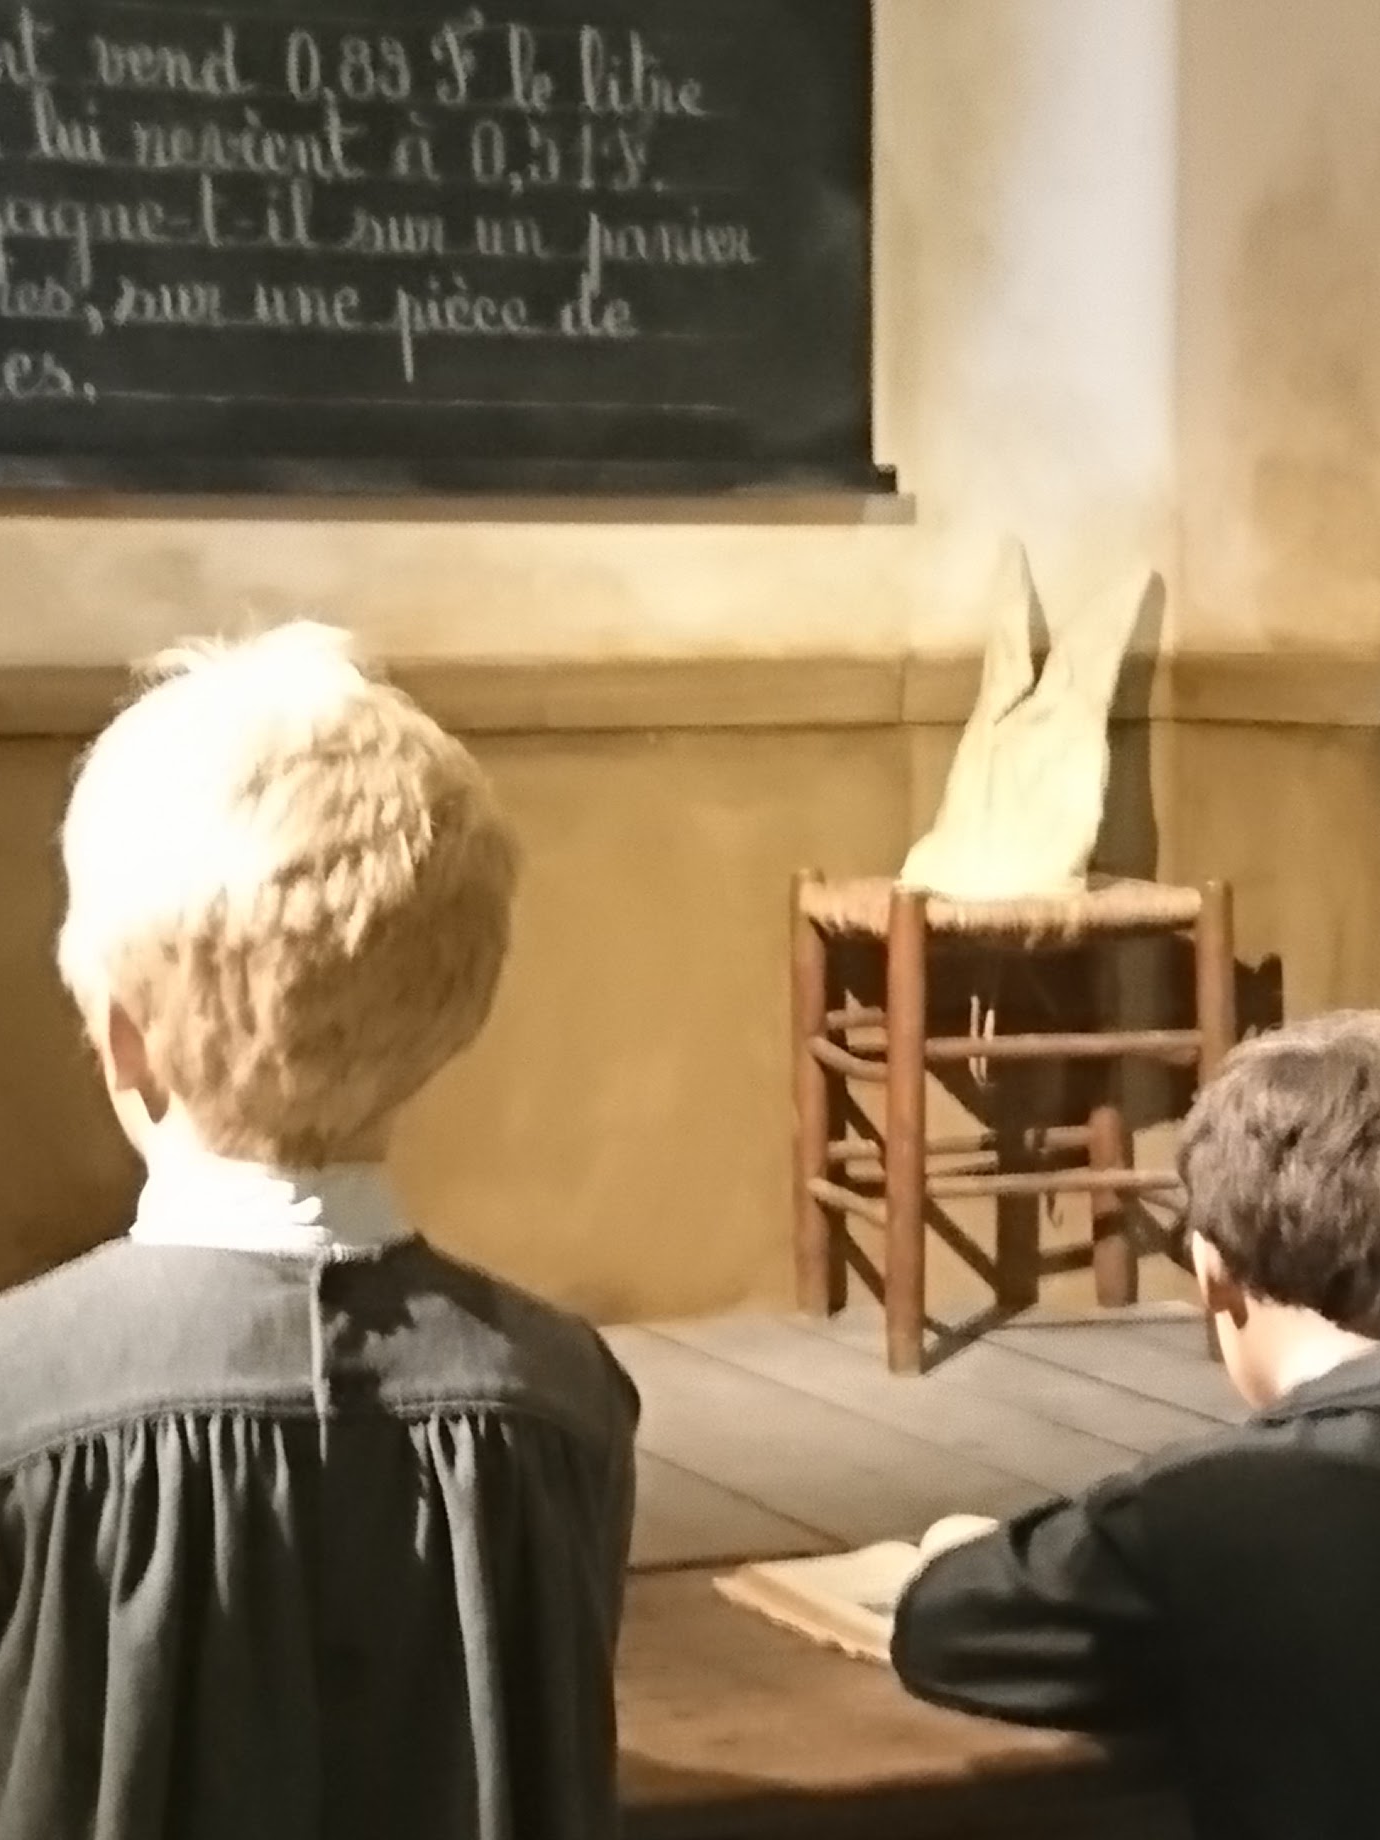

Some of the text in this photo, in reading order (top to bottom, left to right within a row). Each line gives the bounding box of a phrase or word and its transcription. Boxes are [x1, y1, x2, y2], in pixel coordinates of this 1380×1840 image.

[93, 23, 254, 96] vend
[508, 22, 554, 113] le
[580, 24, 706, 115] litre
[33, 83, 104, 162] lui
[132, 87, 366, 181] revient
[390, 110, 443, 183] à
[346, 207, 445, 254] sur
[475, 213, 550, 258] un
[586, 207, 758, 294] panier
[112, 274, 224, 327] sur
[254, 282, 362, 331] une
[394, 271, 532, 383] pièce
[559, 270, 642, 338] de
